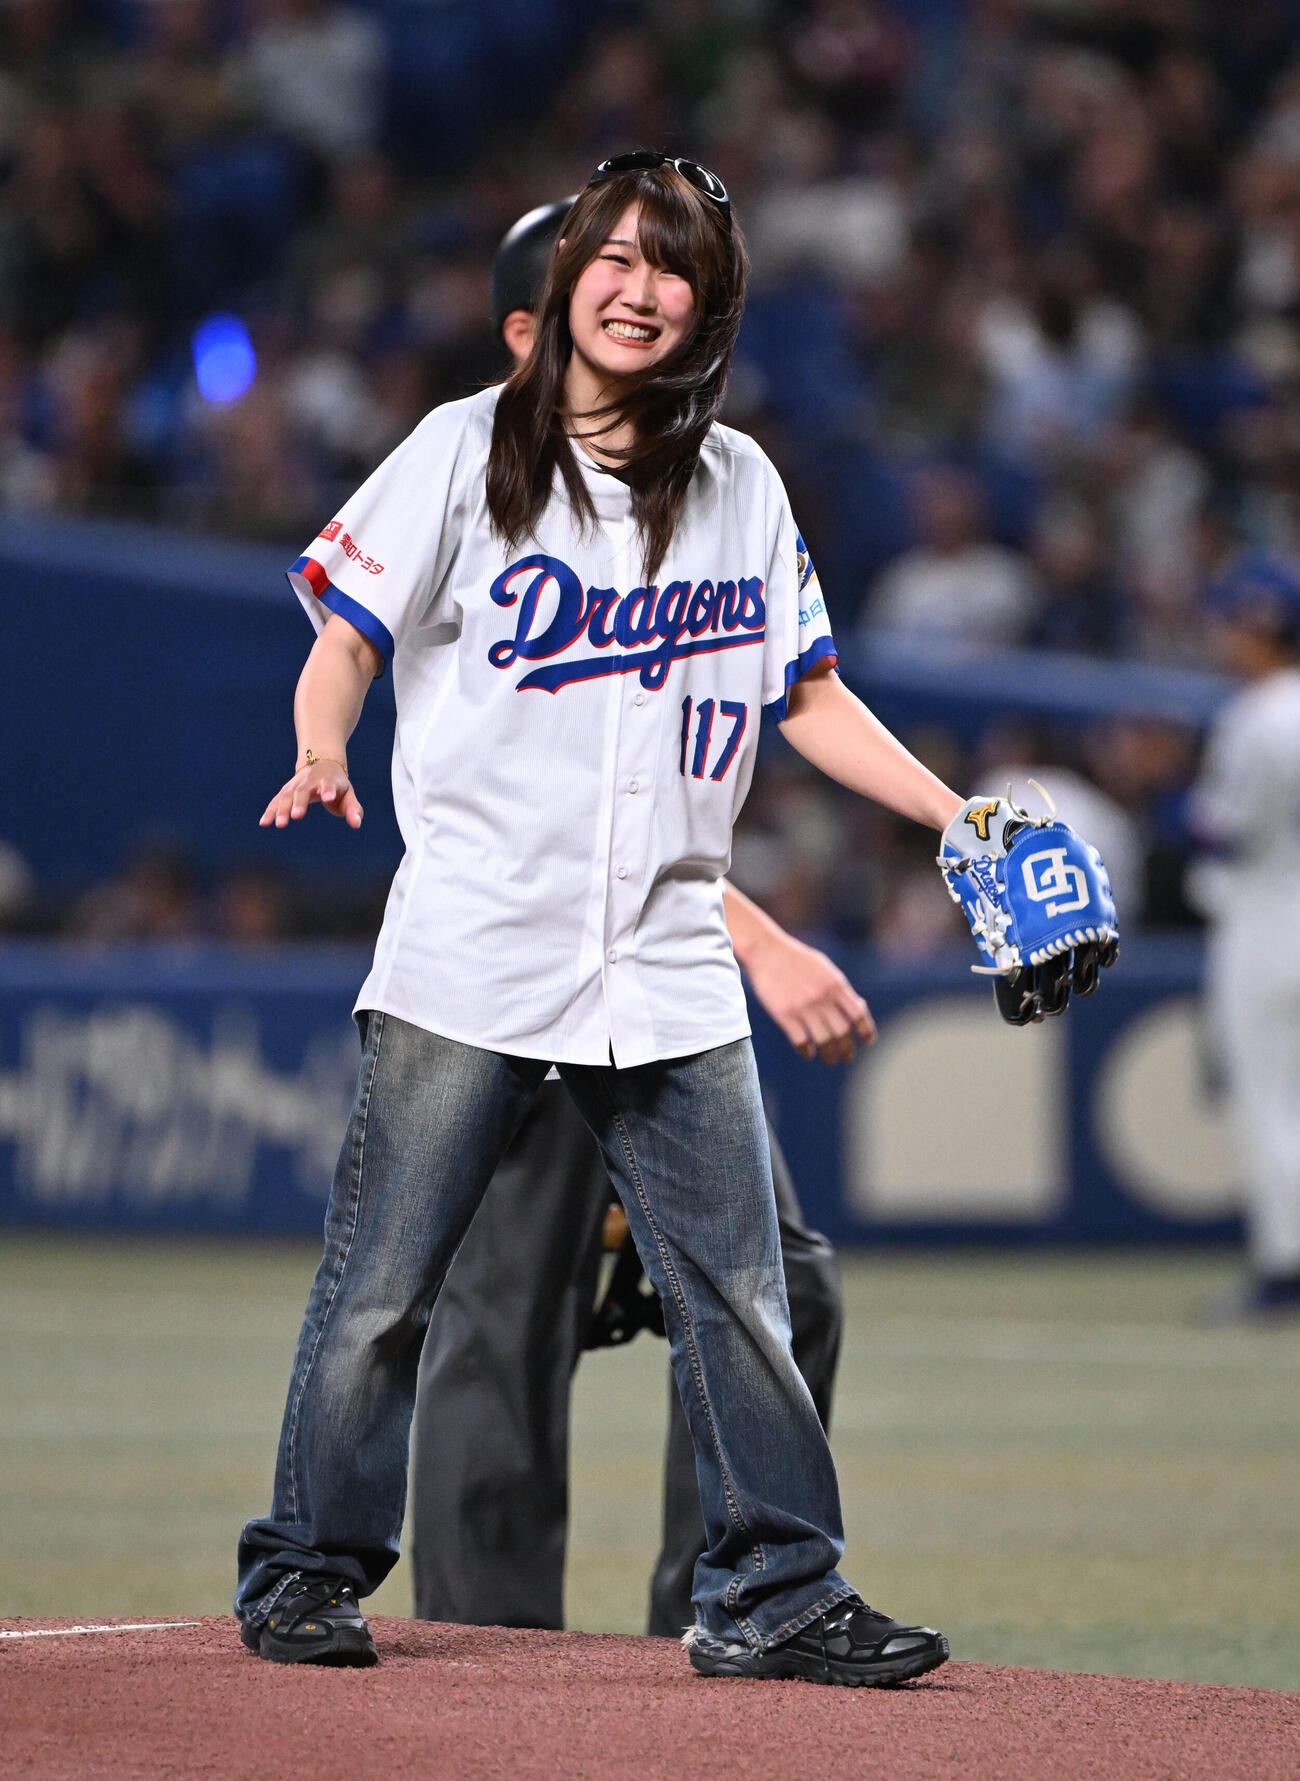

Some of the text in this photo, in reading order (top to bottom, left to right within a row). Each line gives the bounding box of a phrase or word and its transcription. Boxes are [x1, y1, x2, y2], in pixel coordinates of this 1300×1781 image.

[339, 533, 385, 574] 愛知トヨタ
[488, 554, 766, 692] Dragons
[680, 694, 748, 782] 117
